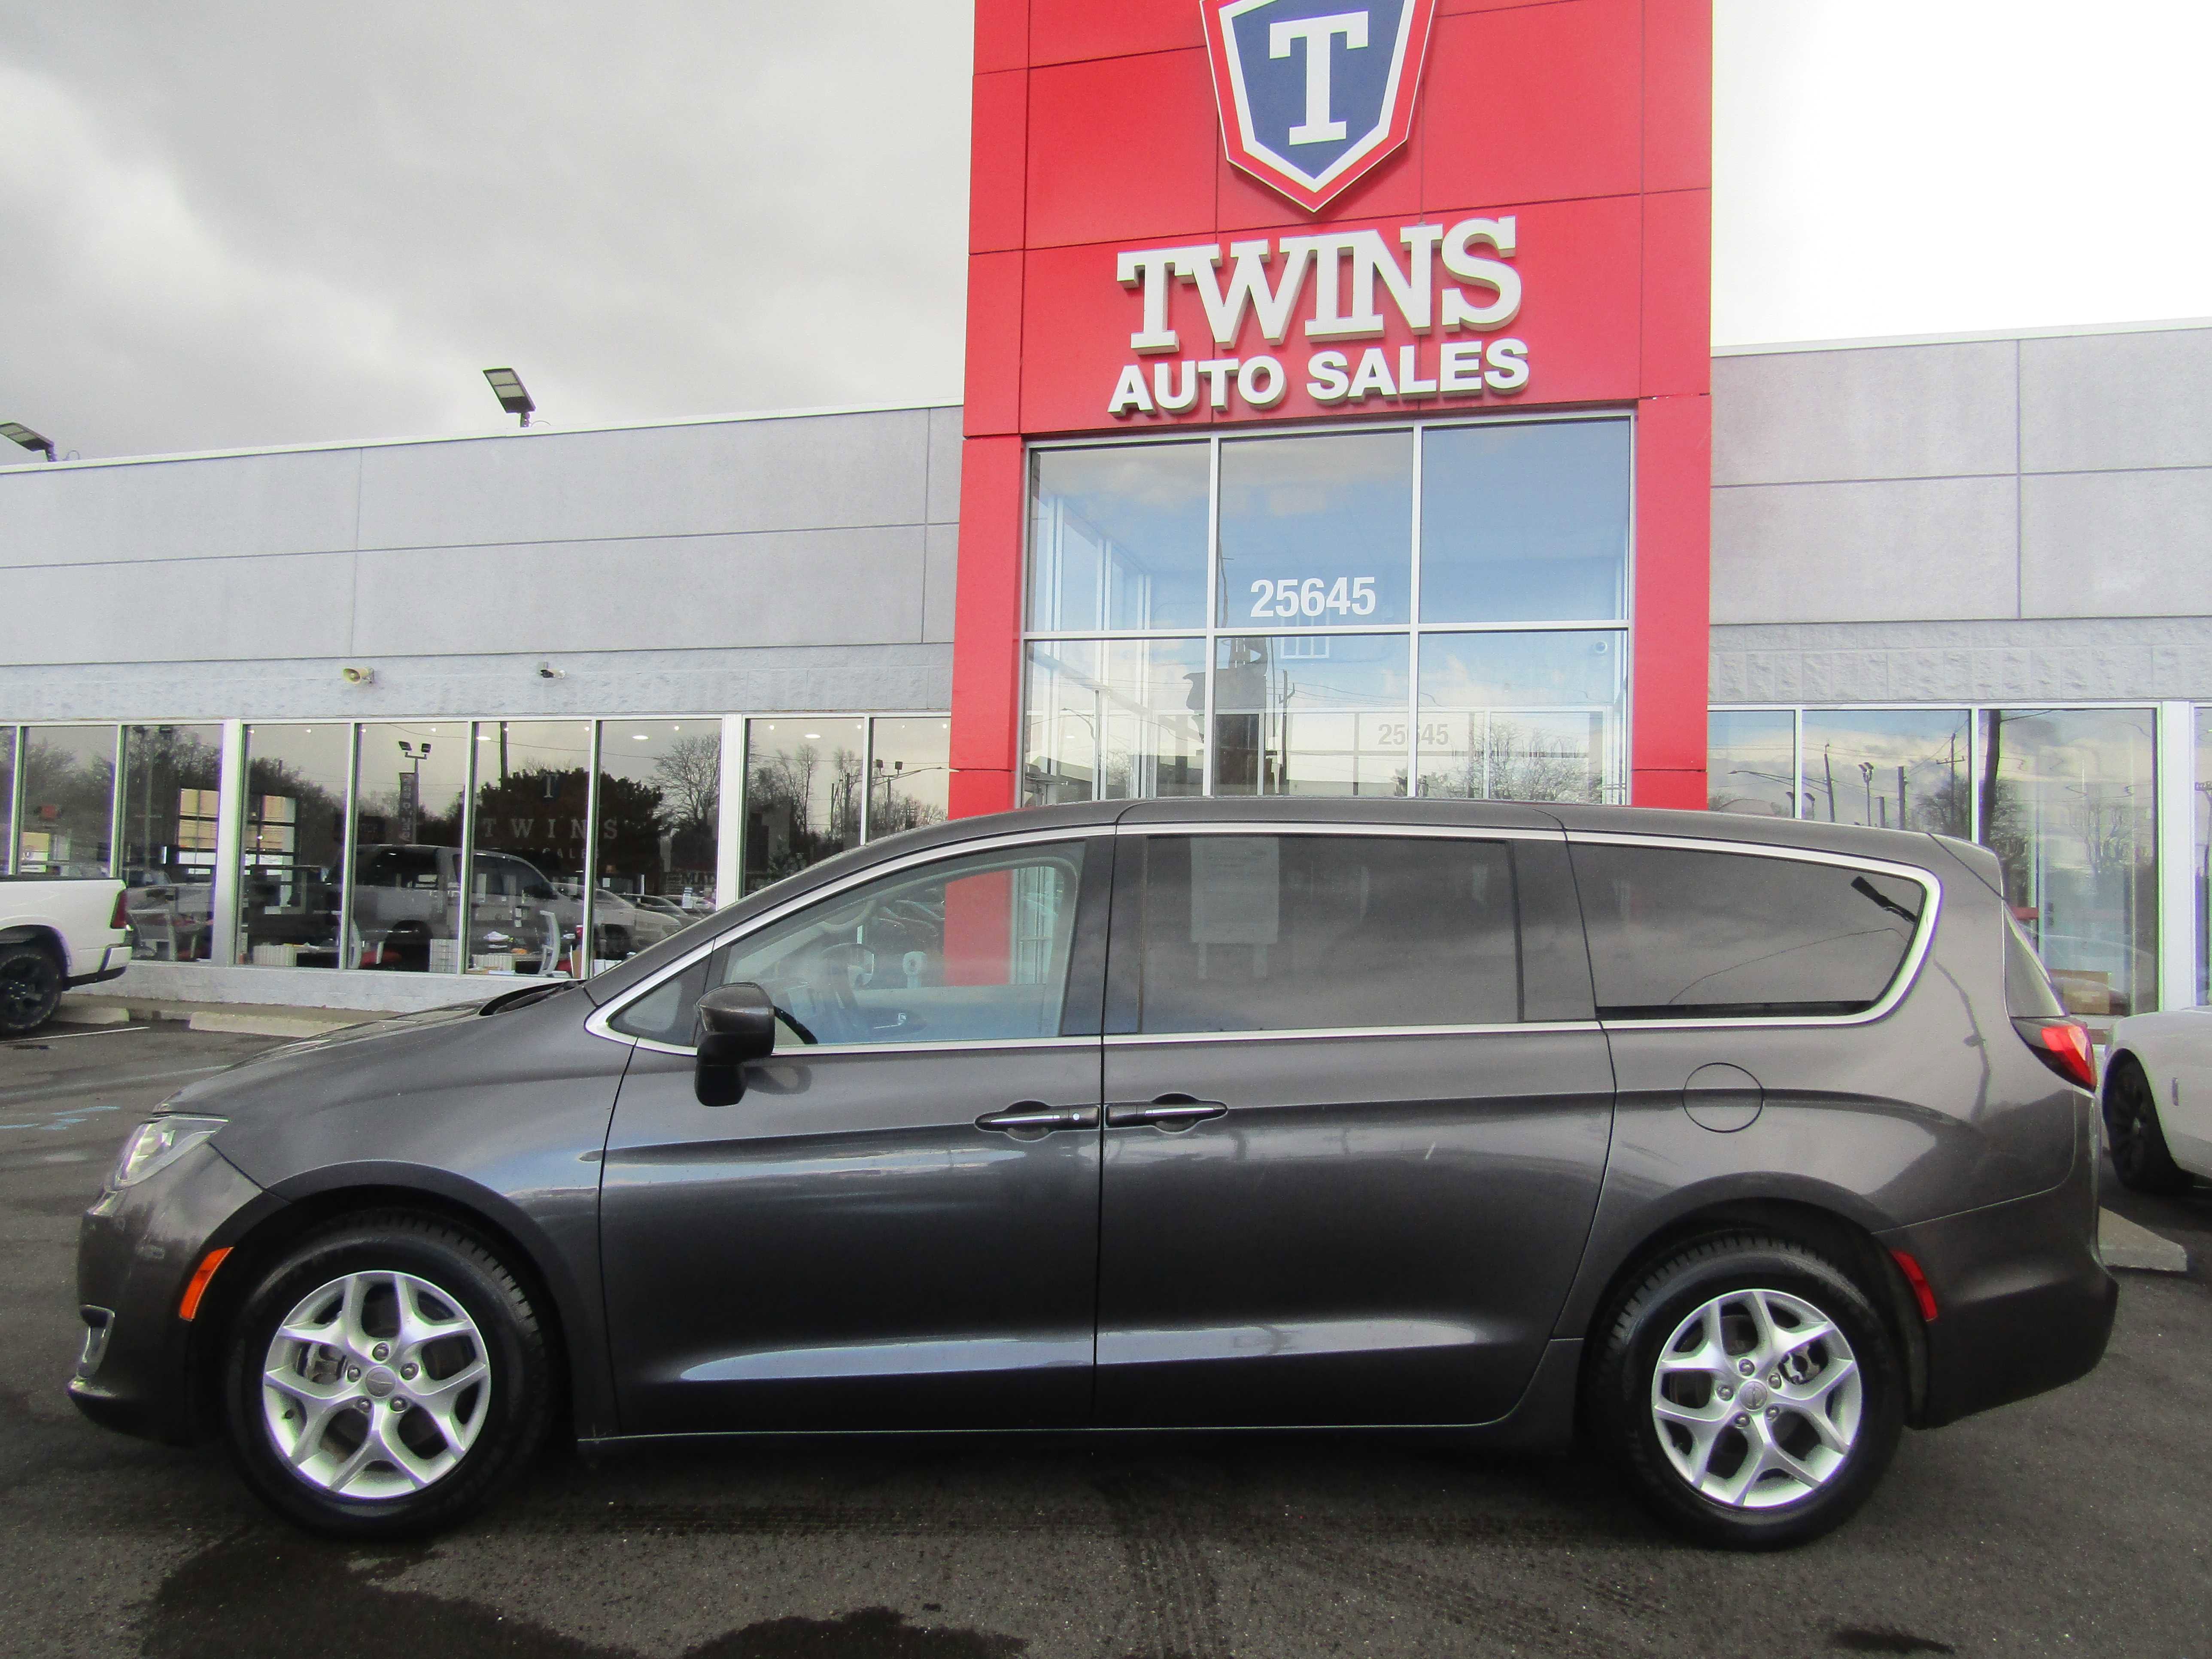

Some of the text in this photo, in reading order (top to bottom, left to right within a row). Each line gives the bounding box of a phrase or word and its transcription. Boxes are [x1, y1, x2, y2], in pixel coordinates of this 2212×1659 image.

[1270, 11, 1368, 145] T
[1117, 216, 1521, 355] TWINS
[1108, 338, 1529, 416] AUTO SALES
[1250, 577, 1376, 617] 25645
[1377, 723, 1449, 745] 2545
